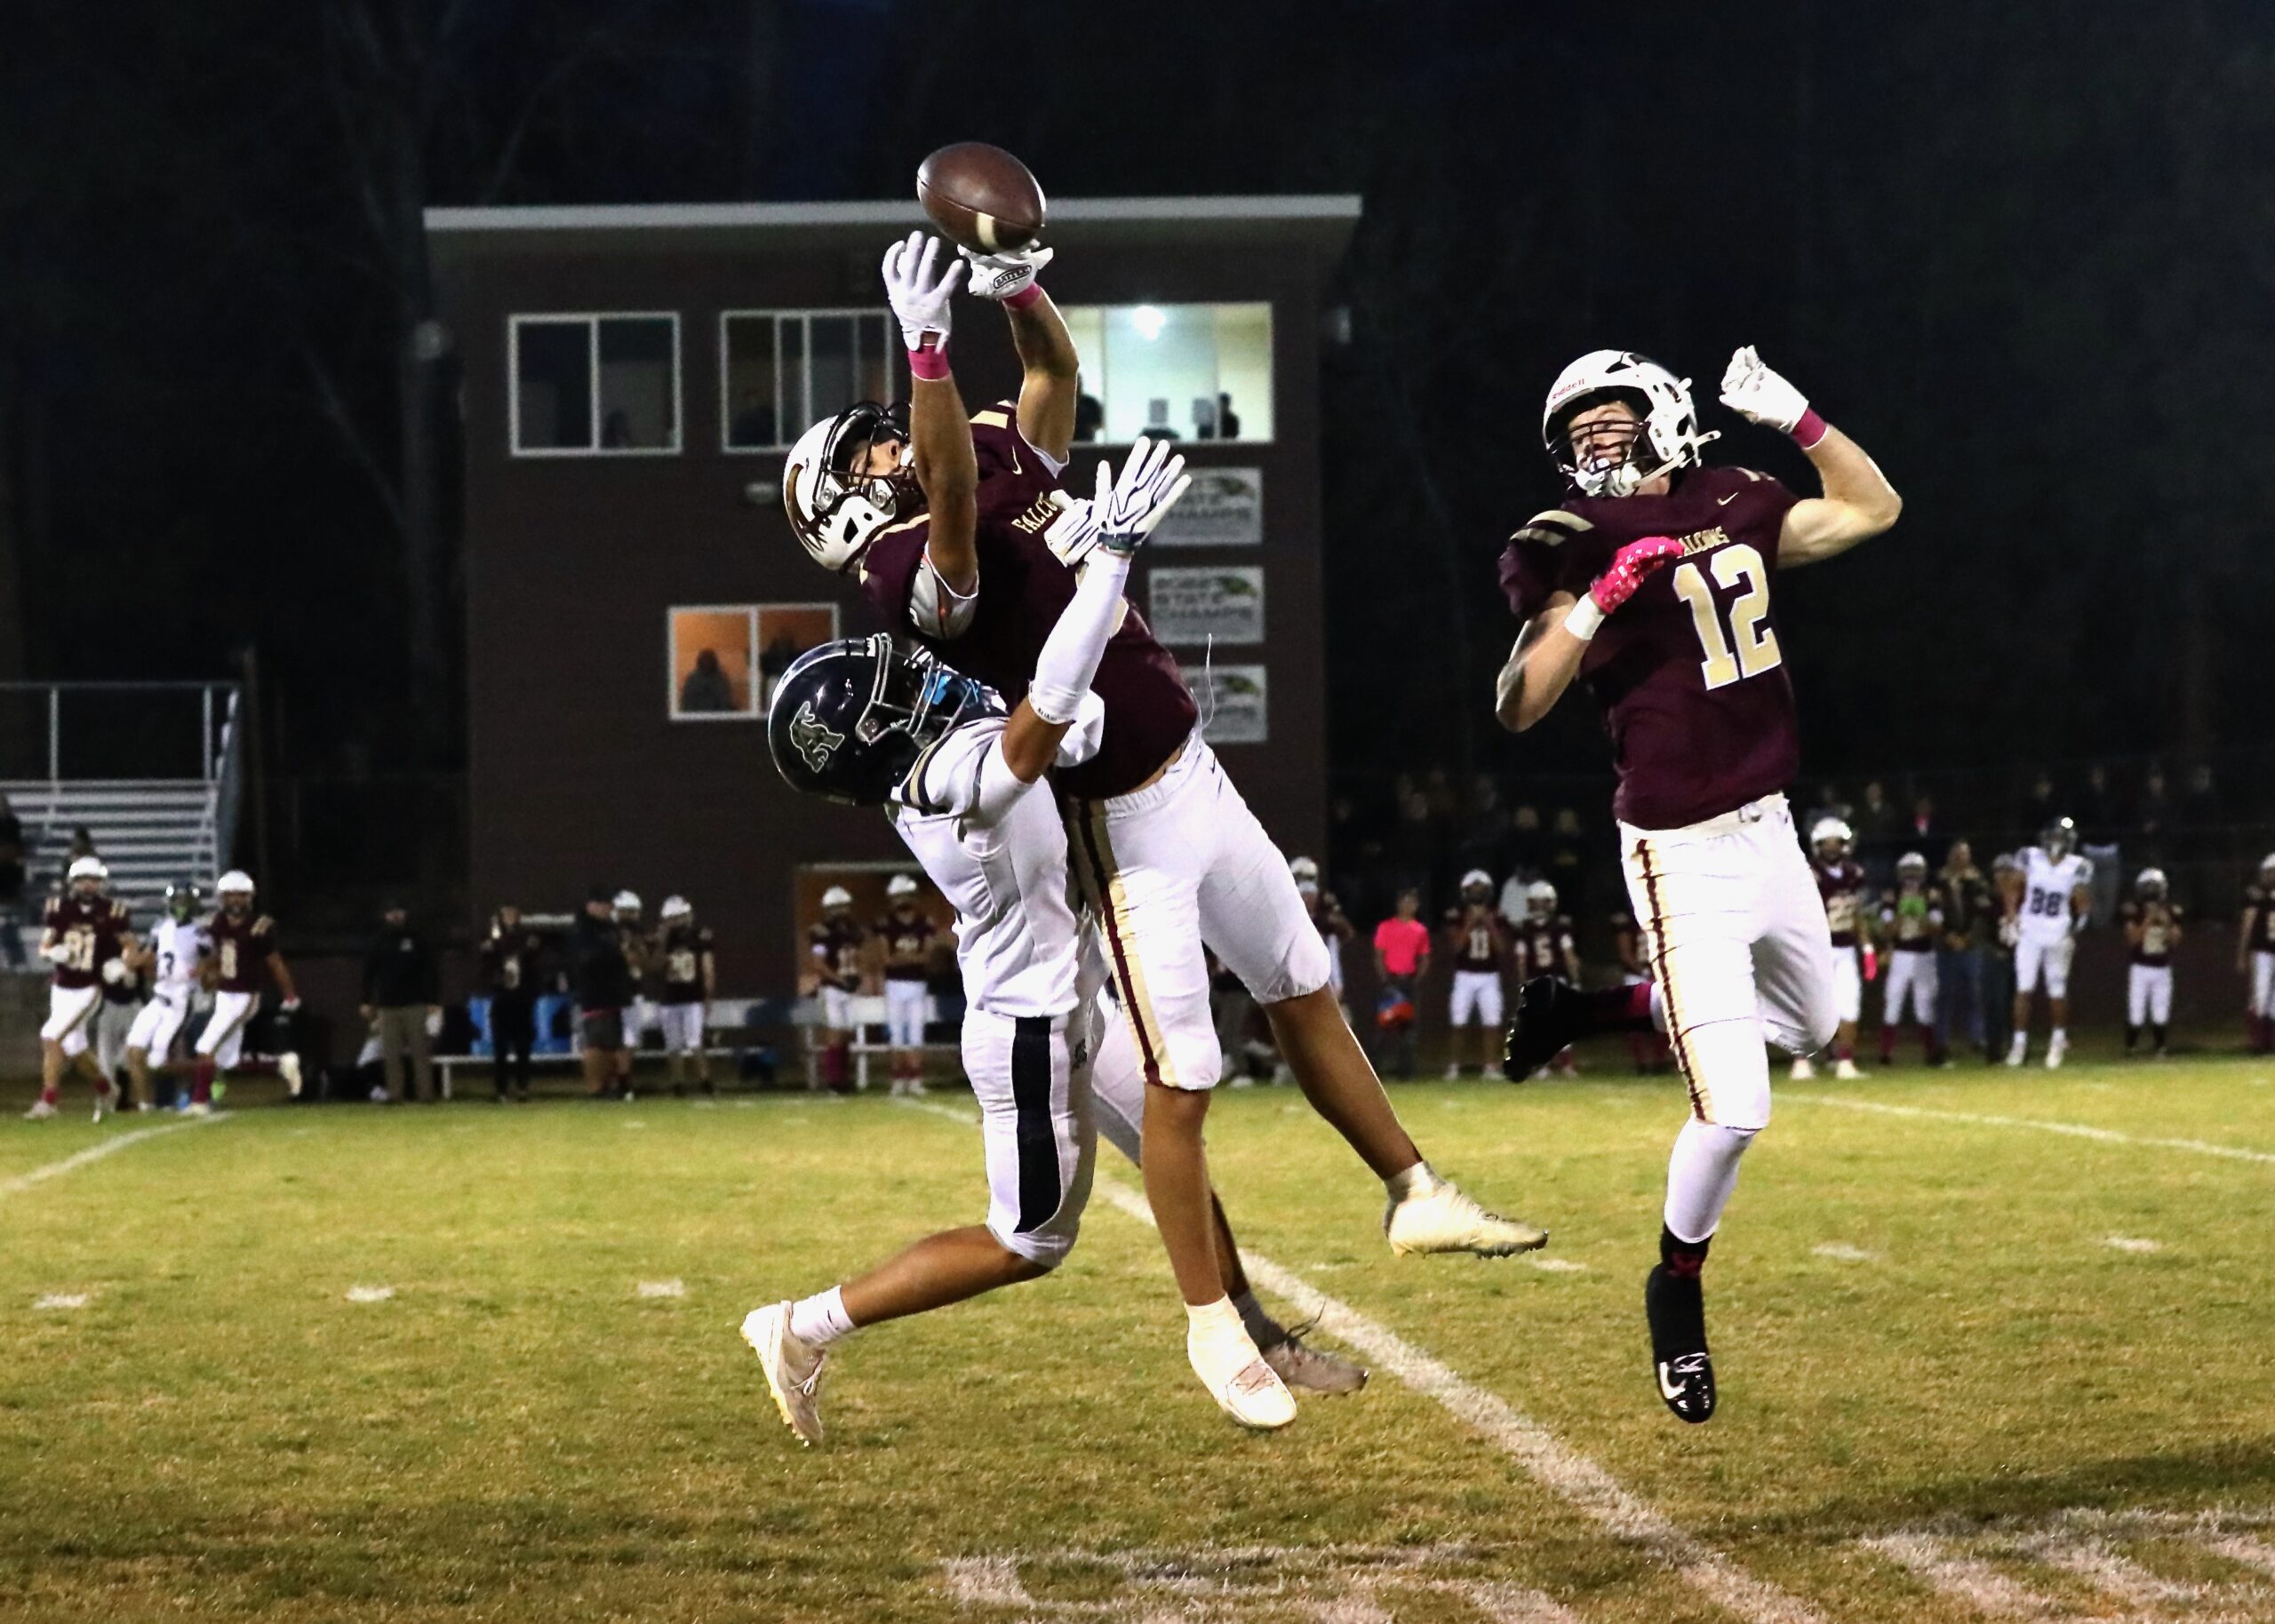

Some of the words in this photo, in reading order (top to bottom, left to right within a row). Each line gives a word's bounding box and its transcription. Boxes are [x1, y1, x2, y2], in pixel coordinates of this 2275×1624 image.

[1676, 525, 1730, 560] ALCONS
[1672, 543, 1783, 691] 12
[1534, 935, 1553, 968] 5
